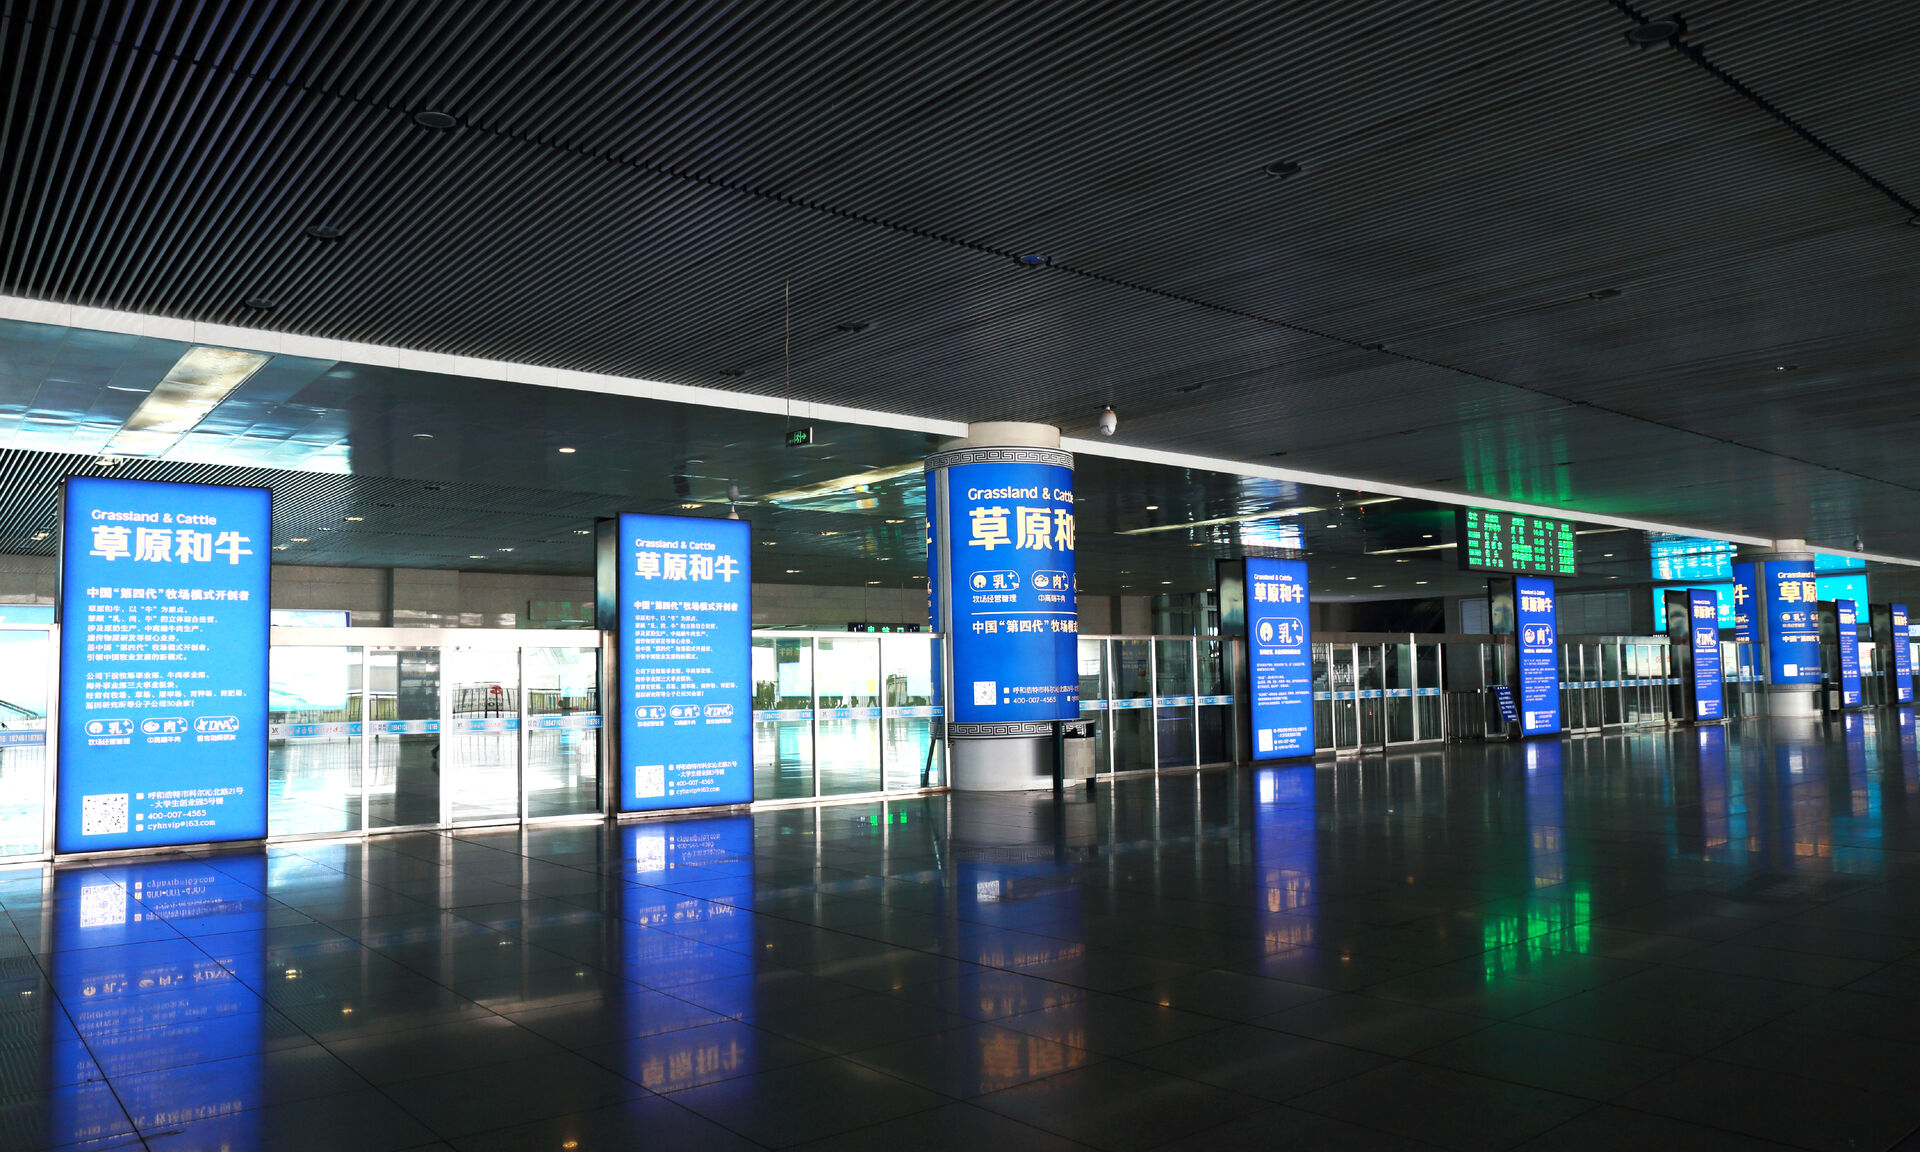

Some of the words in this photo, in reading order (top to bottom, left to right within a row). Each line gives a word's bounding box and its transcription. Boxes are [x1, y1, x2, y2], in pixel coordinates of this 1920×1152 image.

[968, 485, 1038, 501] Grassland
[1043, 487, 1051, 500] &
[91, 509, 159, 523] Grassland
[163, 513, 173, 524] &
[176, 513, 217, 525] Cattle
[89, 525, 253, 565] 草原和牛
[635, 538, 679, 549] Grassland
[689, 541, 716, 551] Cattle
[634, 551, 740, 582] 草原和牛
[1254, 582, 1305, 603] 草原和牛
